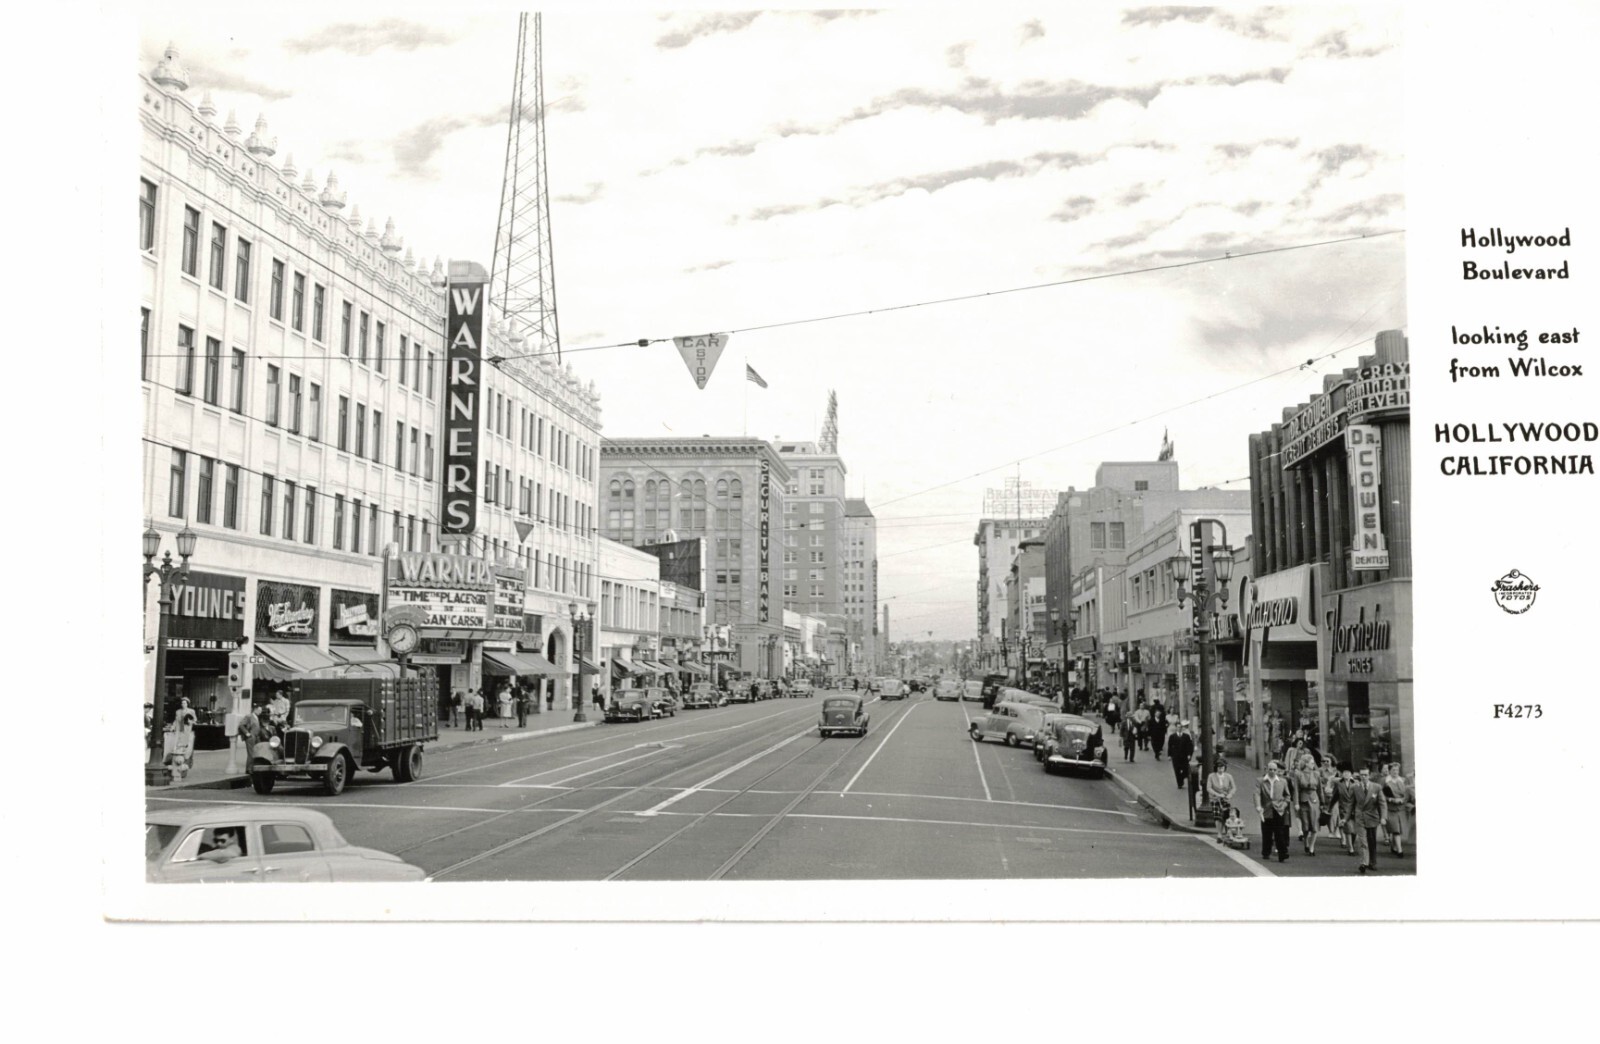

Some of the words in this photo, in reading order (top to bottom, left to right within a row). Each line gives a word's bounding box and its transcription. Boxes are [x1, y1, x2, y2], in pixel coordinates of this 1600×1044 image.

[682, 337, 720, 348] CAR
[695, 348, 706, 385] STOP
[1356, 362, 1409, 382] X-RAY
[447, 287, 481, 529] WARNERS
[760, 460, 769, 560] SECURITY
[1360, 450, 1379, 550] COWEN
[401, 555, 492, 585] WARNERS
[1354, 556, 1388, 565] DENTIST
[402, 590, 430, 602] TIME
[760, 571, 769, 621] BANK
[451, 615, 484, 627] CARSON
[1326, 594, 1391, 674] Florsheim
[1347, 657, 1374, 674] SHOES
